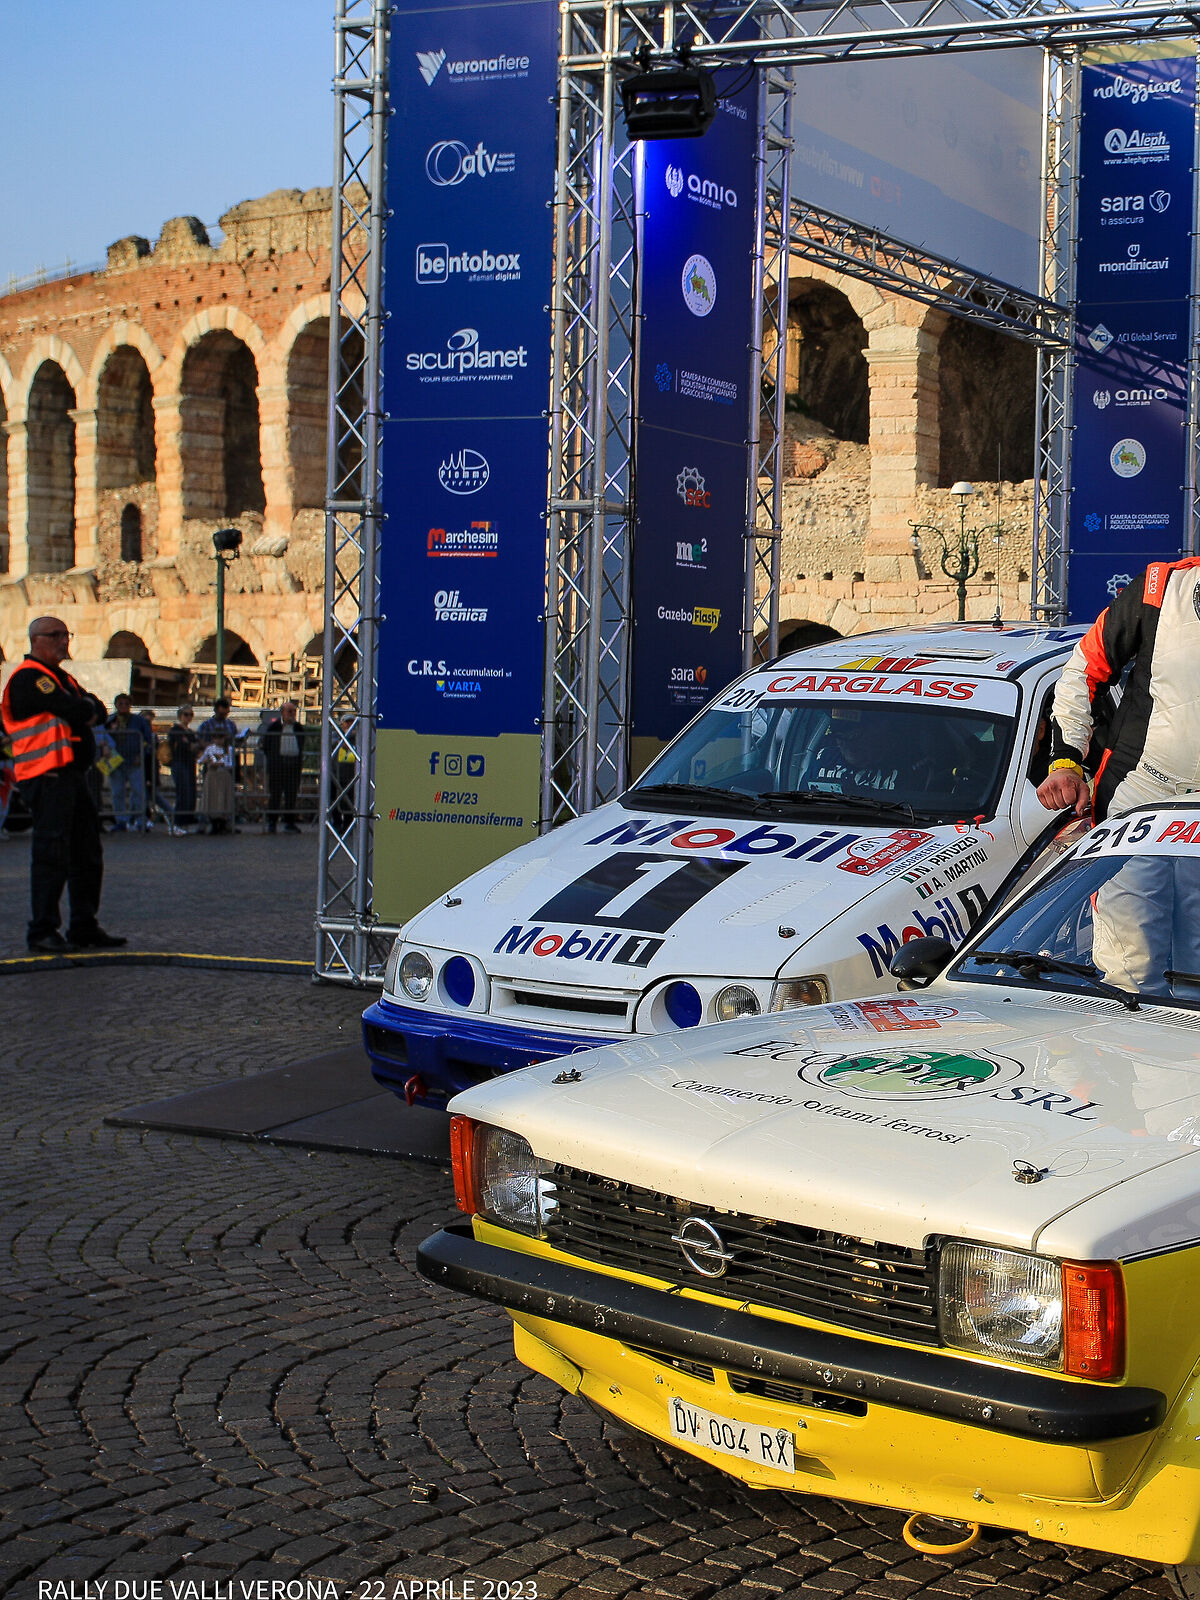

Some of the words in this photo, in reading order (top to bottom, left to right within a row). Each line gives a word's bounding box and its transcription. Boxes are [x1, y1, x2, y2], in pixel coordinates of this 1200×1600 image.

[446, 54, 529, 75] veronafiere
[1093, 76, 1181, 104] noleggiare
[1126, 129, 1167, 148] Aleph
[462, 142, 498, 178] atv
[687, 174, 737, 208] amia
[1101, 195, 1145, 212] sara
[1108, 216, 1144, 225] assicura
[419, 250, 520, 274] bentobox
[1099, 257, 1169, 272] mondinicavi
[1131, 332, 1153, 342] Global
[1154, 331, 1177, 341] Servizi
[406, 341, 528, 373] sicurplanet
[1115, 388, 1168, 401] amia
[686, 488, 711, 508] SEC
[427, 528, 498, 550] Marchesini
[434, 607, 488, 622] Tecnica
[658, 606, 693, 622] Gazebo
[694, 609, 717, 624] Flash
[407, 660, 450, 676] C.R.S.
[452, 667, 504, 677] accumulatori
[671, 667, 694, 681] sara
[447, 681, 482, 692] VARTA
[766, 676, 978, 701] CARGLASS
[720, 688, 766, 710] 201
[434, 791, 478, 805] #R2V23
[389, 808, 523, 827] #lapassionenonsiferma
[583, 819, 862, 863] Mobil
[1080, 815, 1157, 858] 215
[917, 863, 934, 876] N.
[929, 836, 979, 867] PATUZZO
[931, 876, 947, 892] A.
[943, 847, 989, 884] MARTINI
[595, 860, 691, 918] 1
[493, 925, 623, 963] Mobil
[628, 938, 650, 962] 1
[672, 1079, 793, 1106] Commercio
[881, 1117, 971, 1145] ferrosi
[990, 1086, 1104, 1121] SRL
[675, 1406, 698, 1438] DV
[709, 1418, 750, 1454] 004
[760, 1432, 789, 1467] RX
